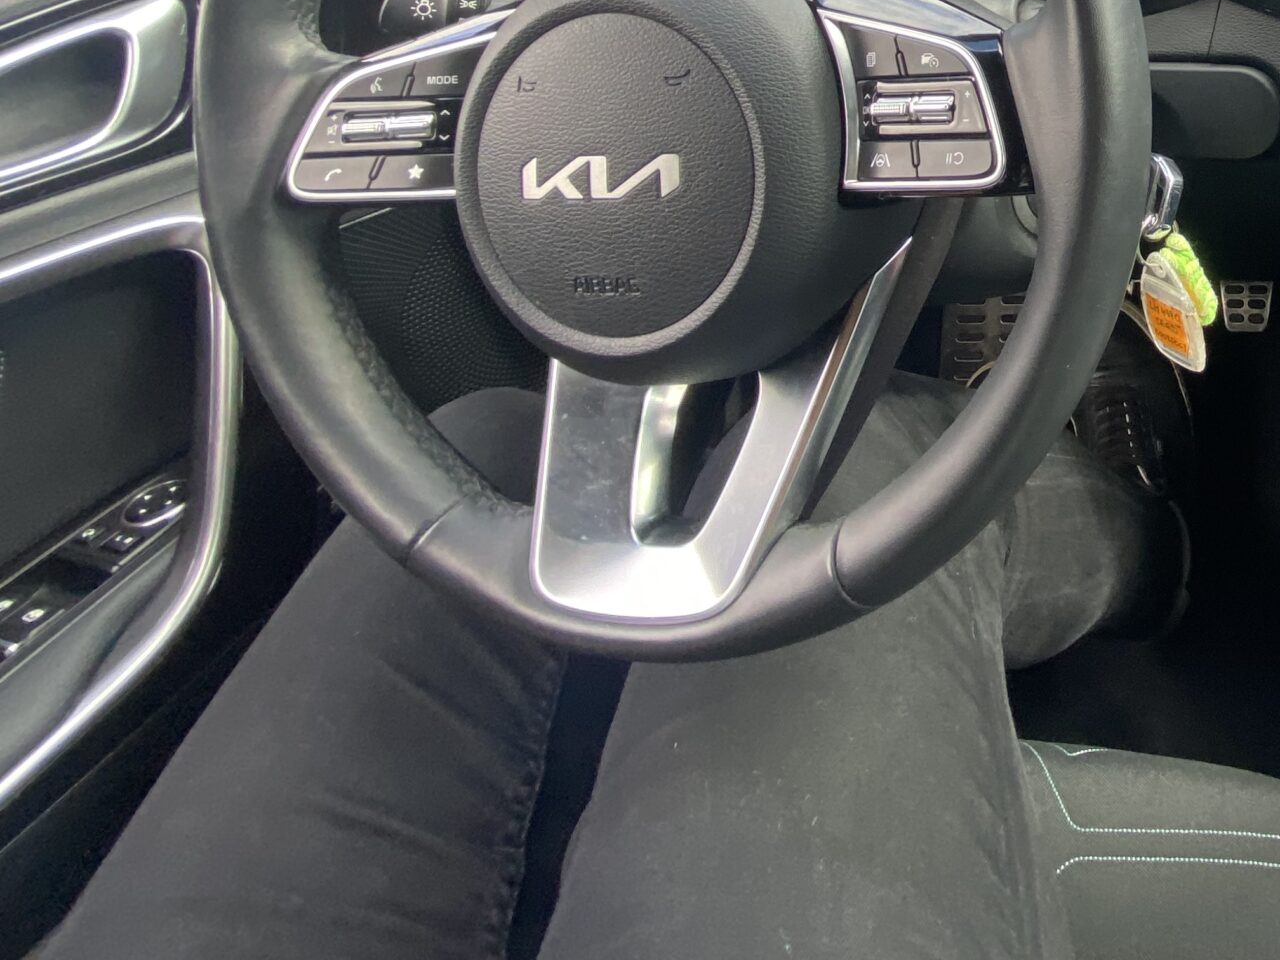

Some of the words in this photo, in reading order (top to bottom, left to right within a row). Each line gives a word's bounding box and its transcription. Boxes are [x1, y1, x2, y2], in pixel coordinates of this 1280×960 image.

[426, 75, 458, 85] MODE
[522, 153, 680, 200] KIA
[574, 276, 641, 296] AIRBAG
